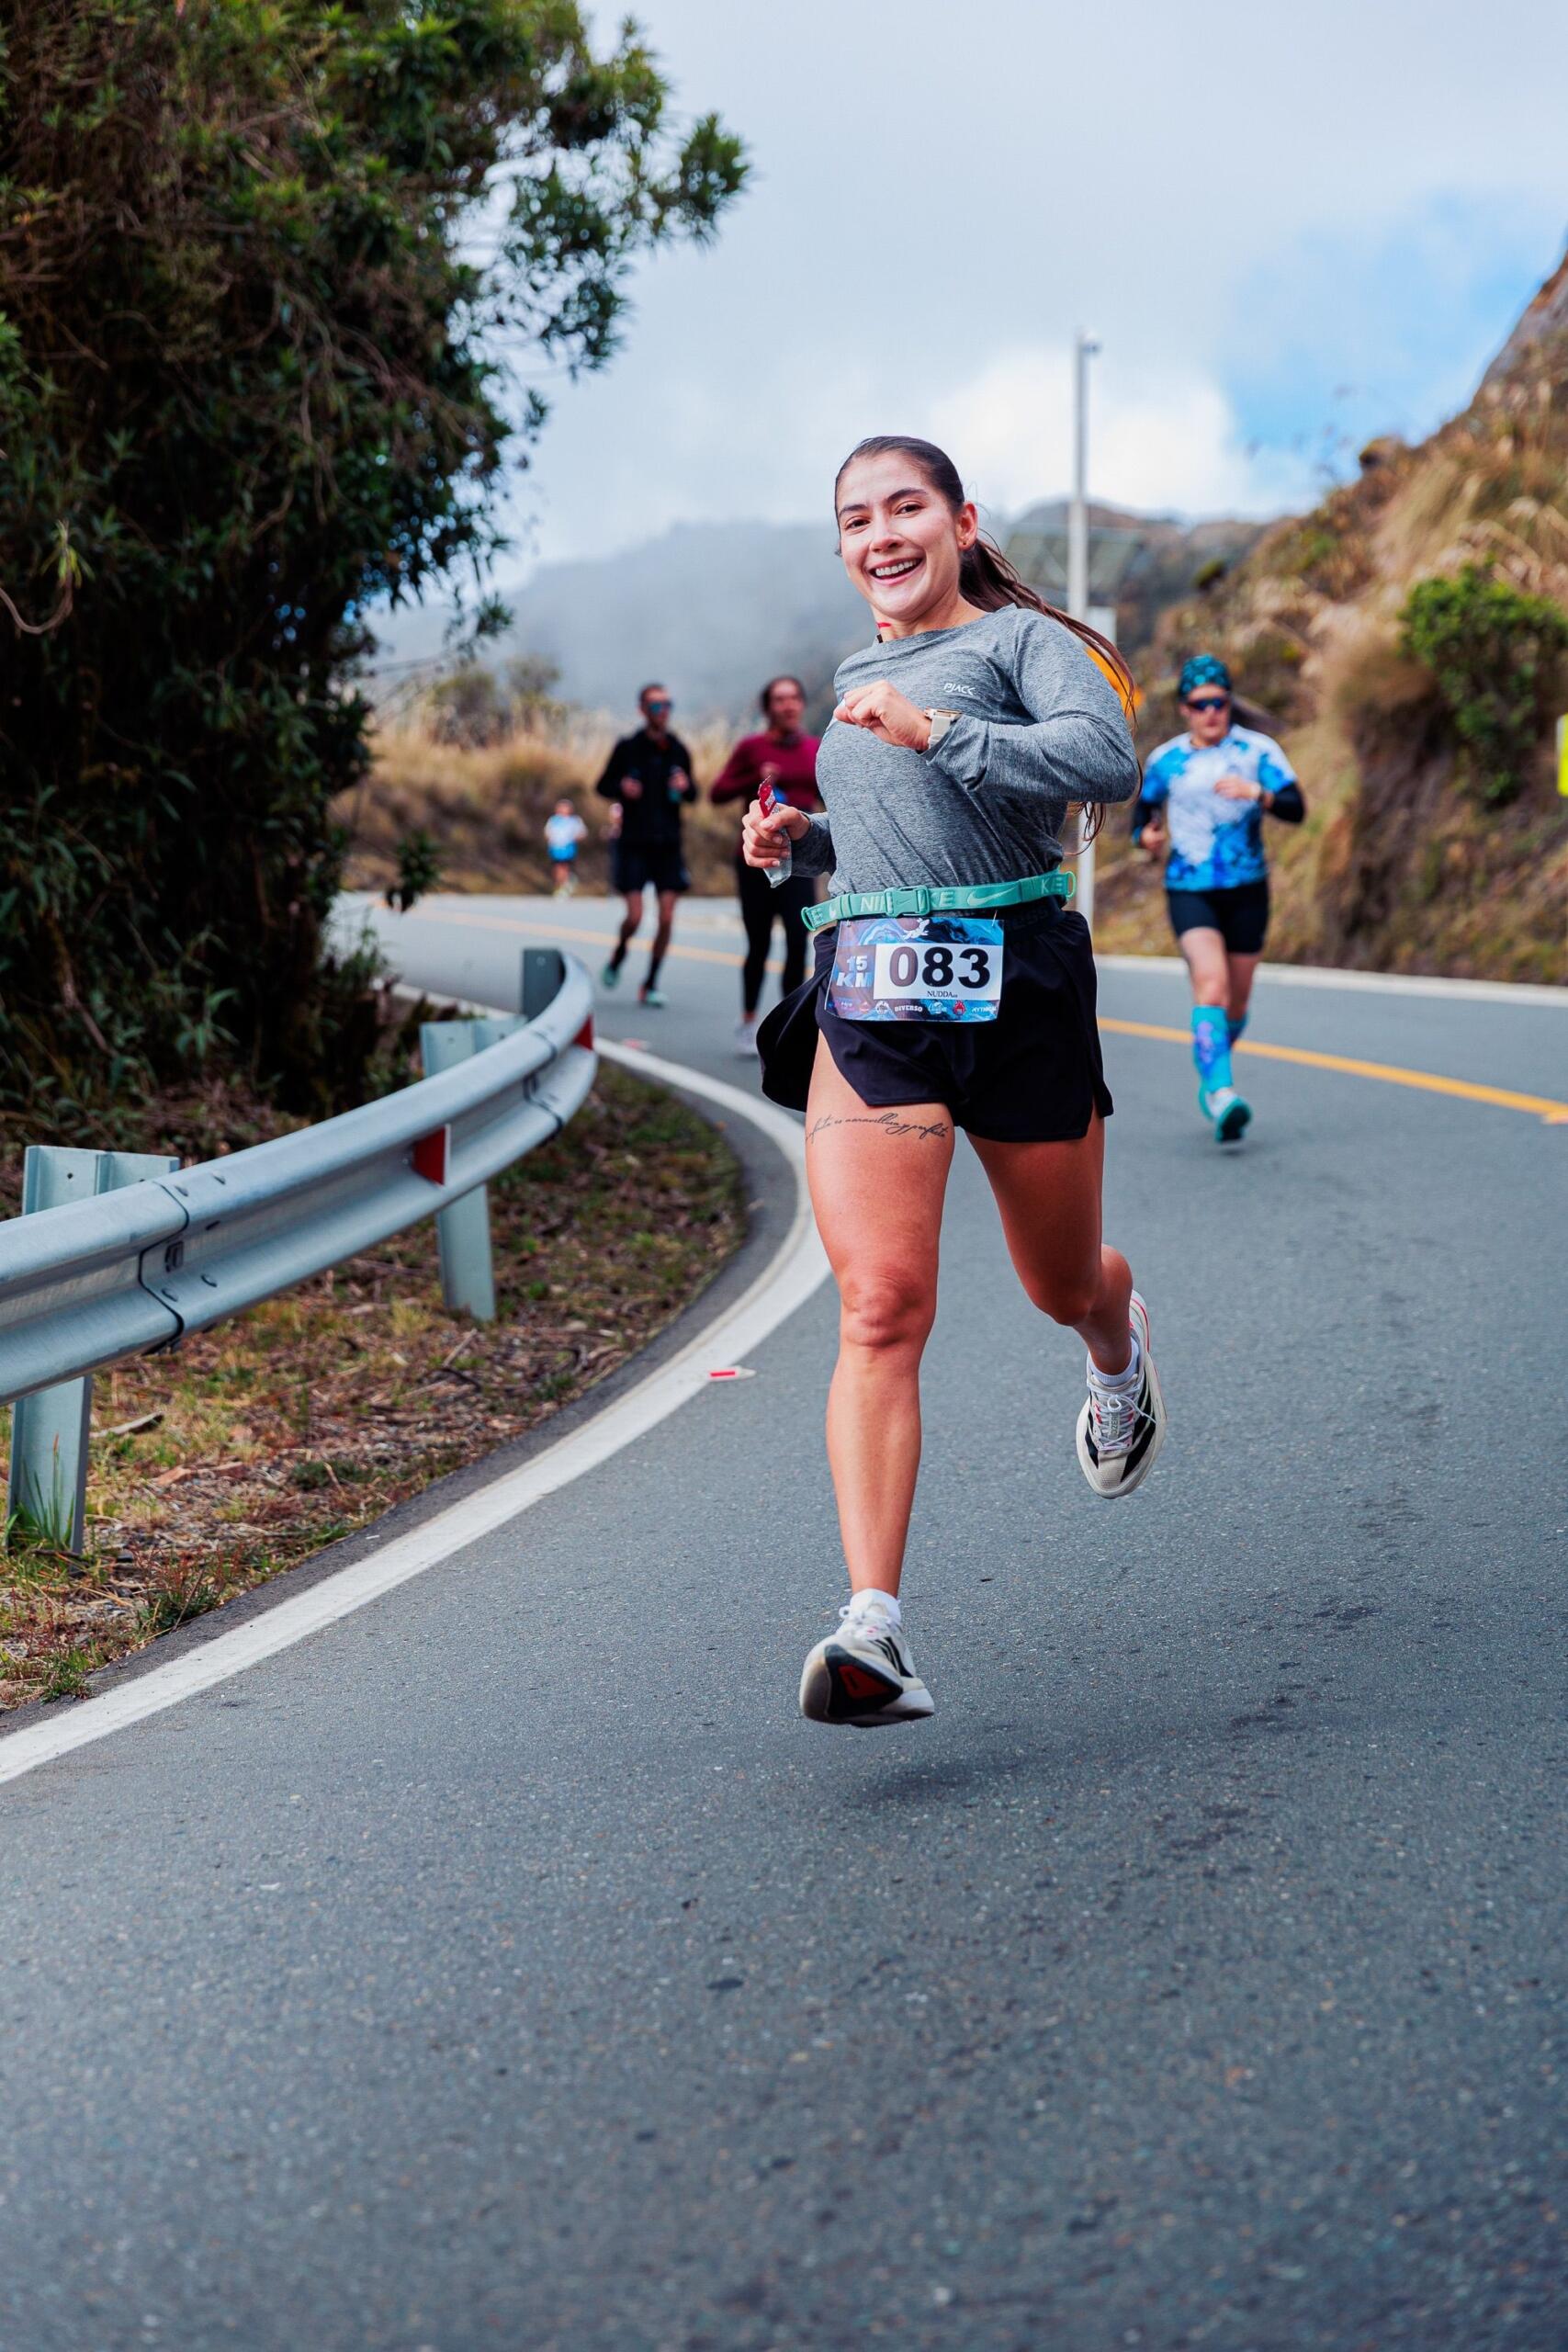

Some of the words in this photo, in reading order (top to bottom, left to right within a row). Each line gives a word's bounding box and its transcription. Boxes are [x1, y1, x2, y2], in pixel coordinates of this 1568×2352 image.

[846, 956, 867, 971] 15
[889, 946, 990, 989] 083
[837, 972, 874, 988] KM
